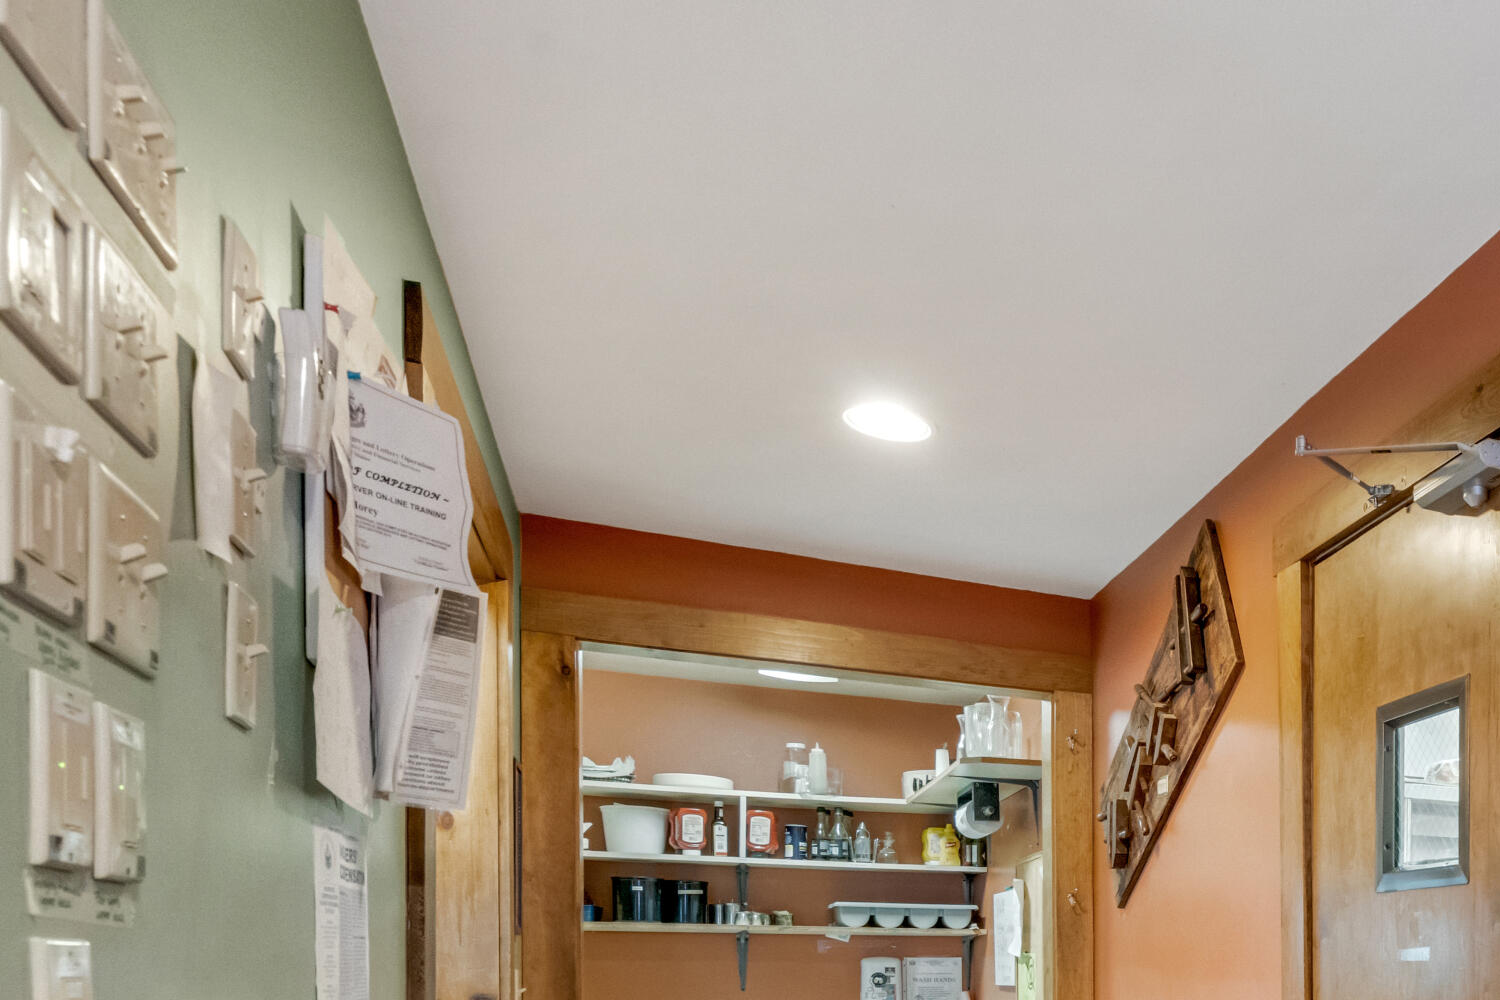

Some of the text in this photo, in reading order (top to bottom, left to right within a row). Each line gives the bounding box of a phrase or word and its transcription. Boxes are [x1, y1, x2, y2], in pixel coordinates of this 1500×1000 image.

[365, 470, 442, 501] COMPLETION
[375, 491, 408, 509] ON-LINE
[409, 502, 447, 520] TRAINING
